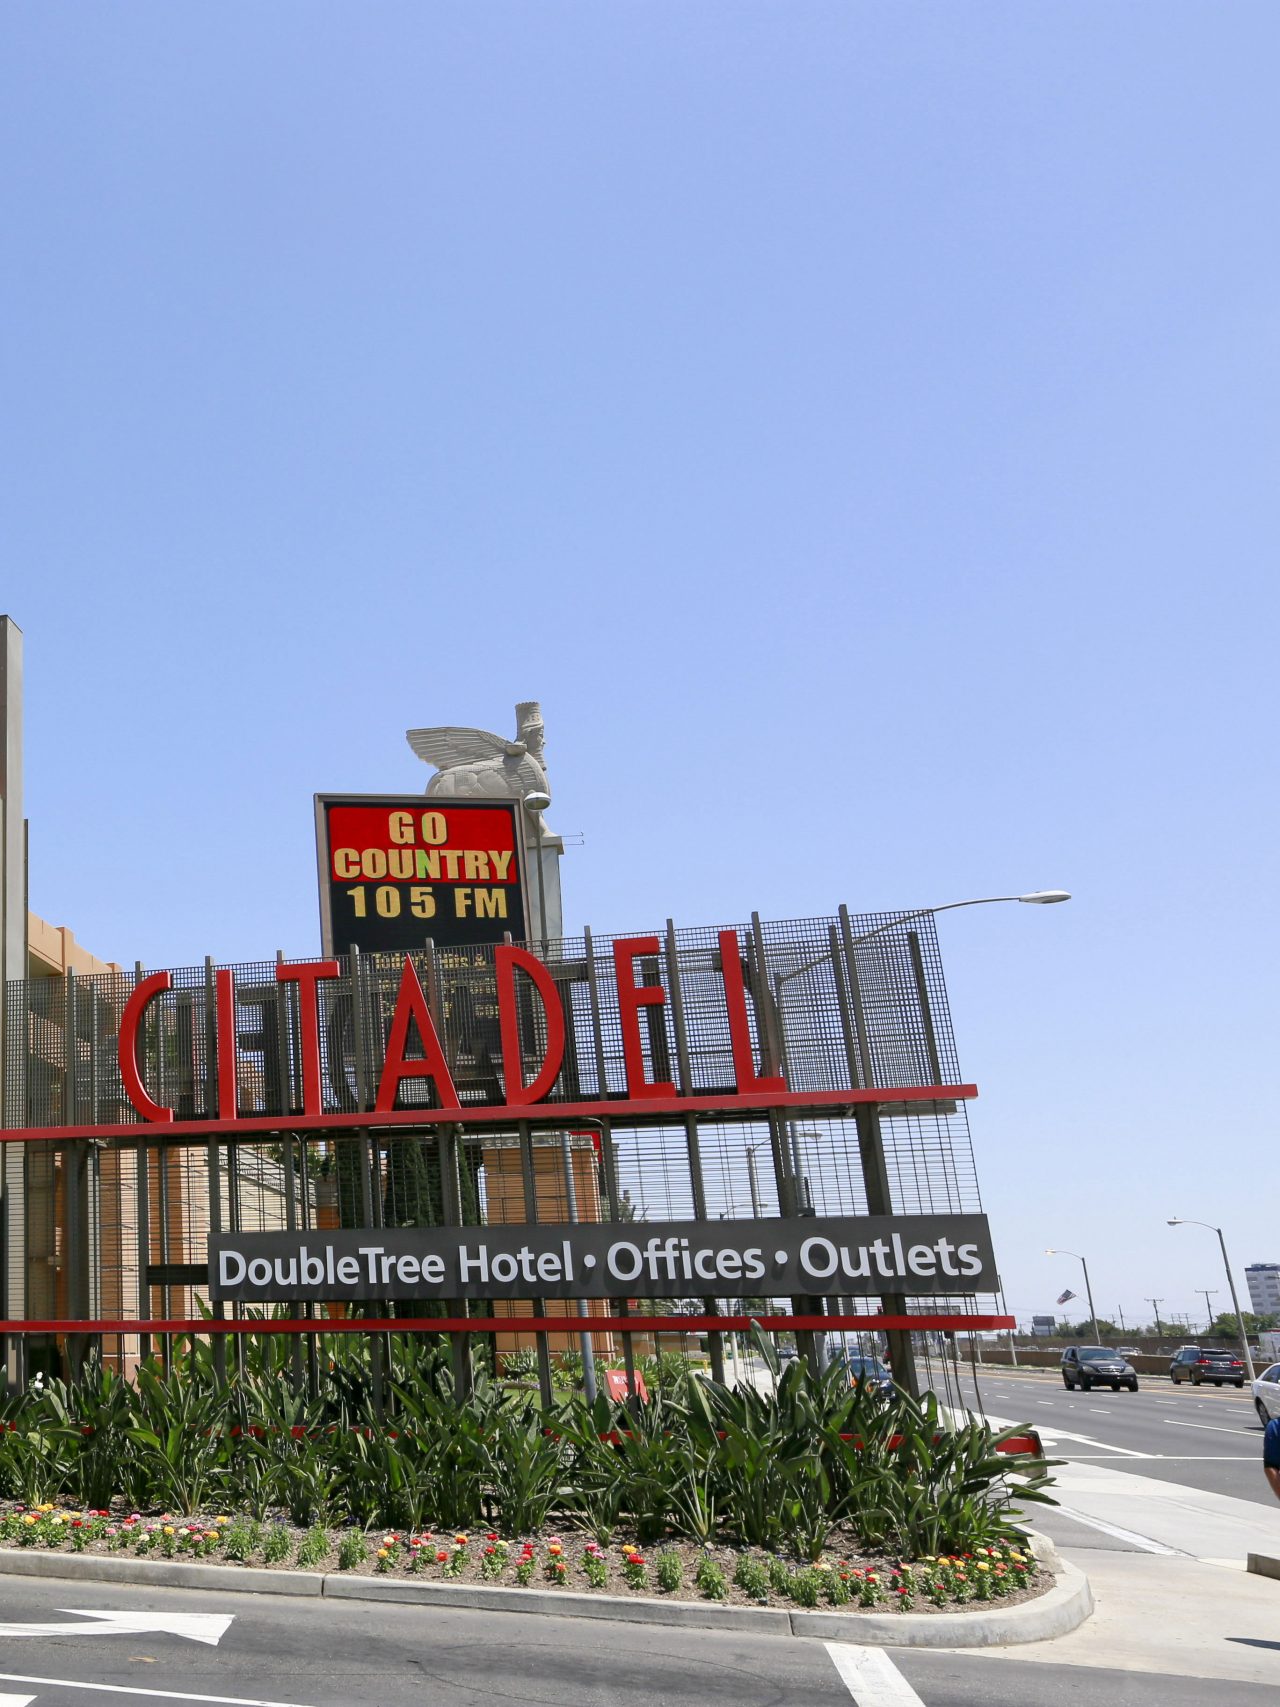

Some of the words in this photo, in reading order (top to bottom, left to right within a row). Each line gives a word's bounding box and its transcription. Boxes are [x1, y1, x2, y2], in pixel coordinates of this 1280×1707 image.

[388, 811, 447, 845] GO
[333, 848, 513, 880] COUNTRY
[346, 886, 436, 919] 105
[454, 888, 508, 919] FM
[119, 930, 786, 1122] CITADEL
[218, 1245, 446, 1287] DoubleTree
[458, 1240, 575, 1283] Hotel
[607, 1237, 766, 1281] Offices
[799, 1232, 983, 1278] Outlets
